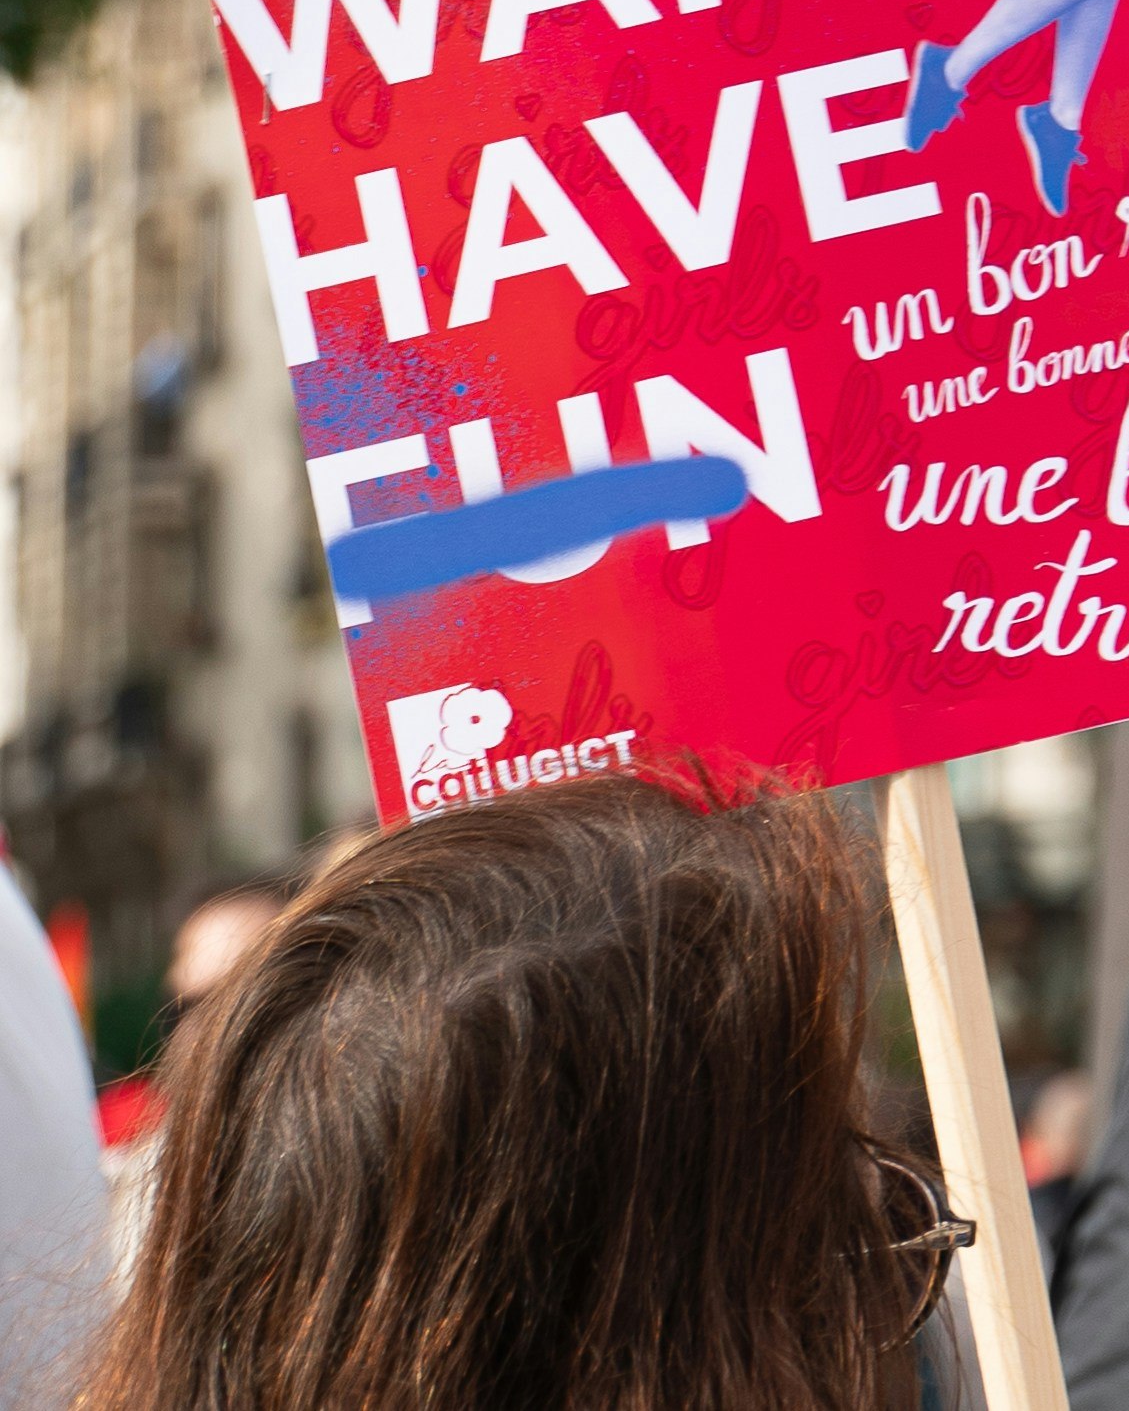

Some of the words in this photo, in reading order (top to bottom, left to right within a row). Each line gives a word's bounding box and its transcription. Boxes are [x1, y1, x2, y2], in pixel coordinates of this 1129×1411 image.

[254, 47, 944, 368] HAVE
[841, 287, 955, 361] un
[966, 191, 1104, 317] bon
[901, 365, 1000, 424] une
[877, 455, 1080, 532] une
[496, 729, 637, 793] UGICT
